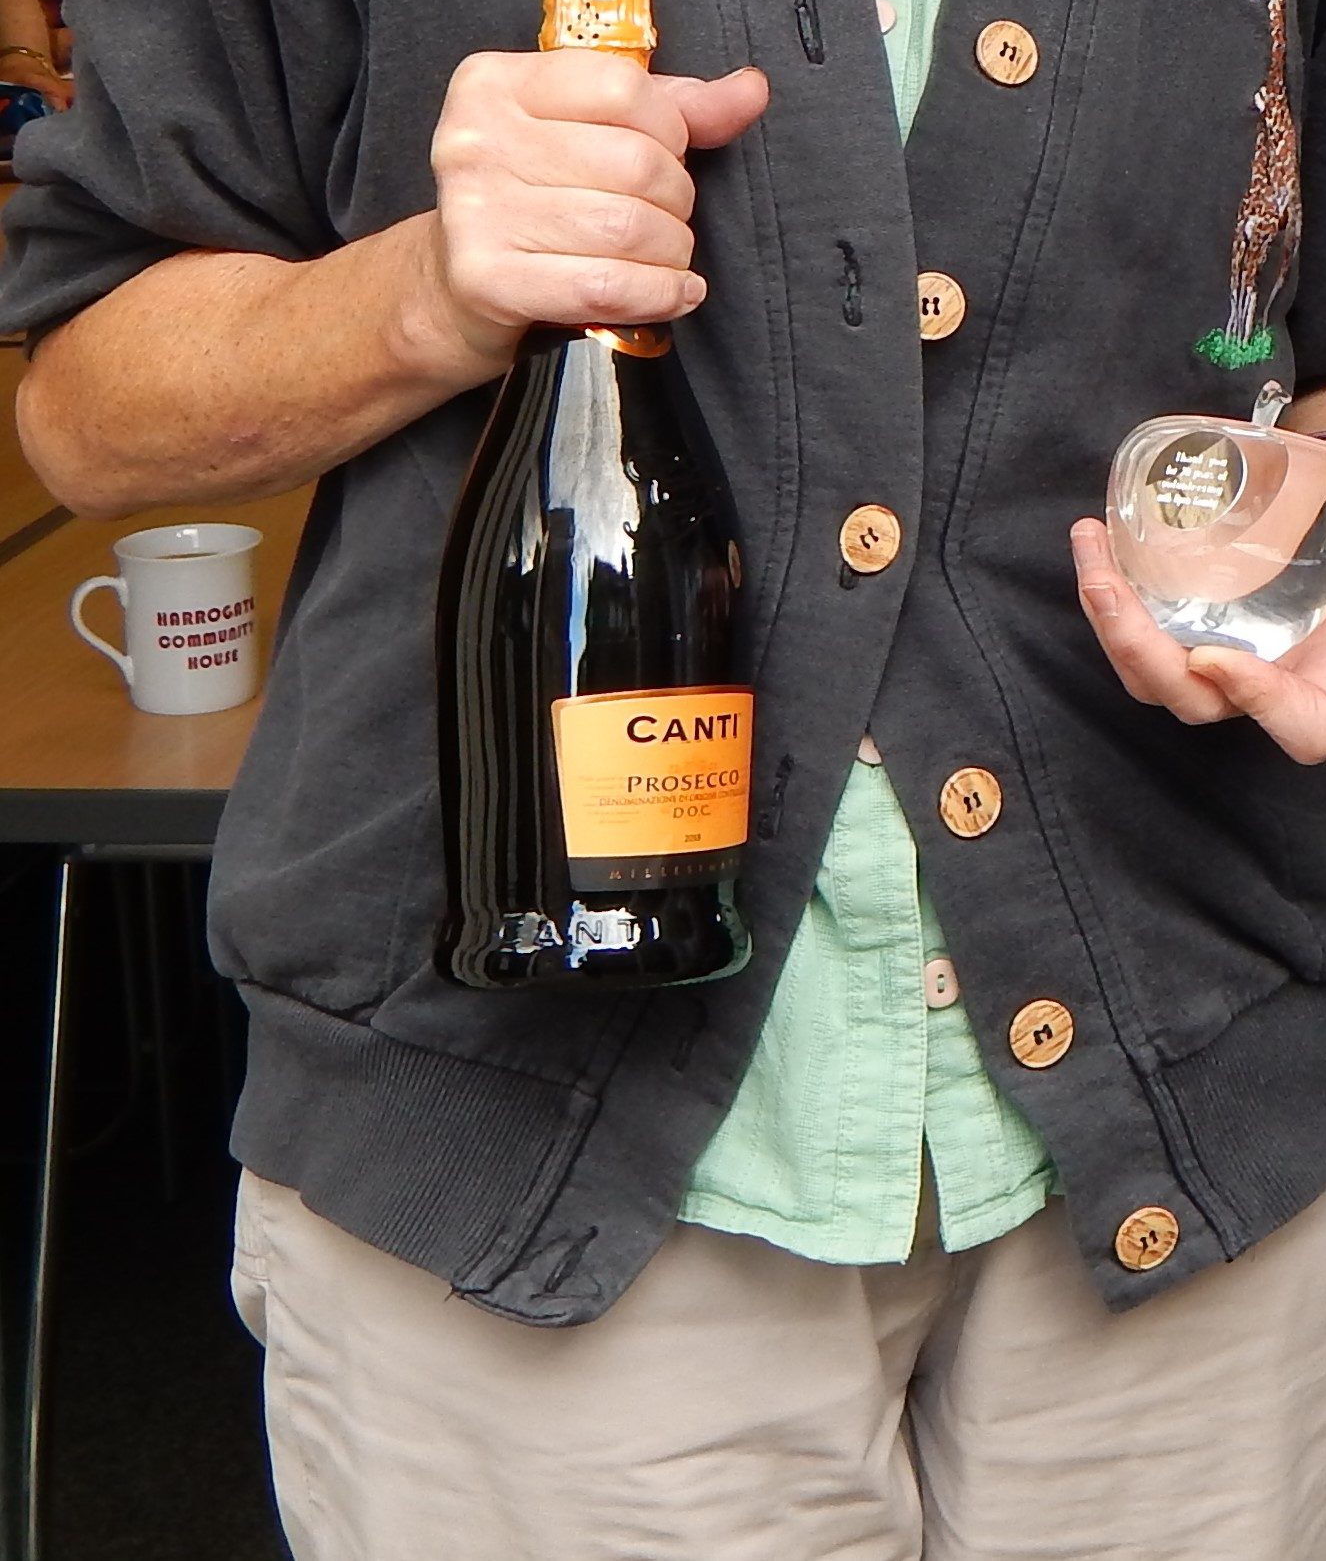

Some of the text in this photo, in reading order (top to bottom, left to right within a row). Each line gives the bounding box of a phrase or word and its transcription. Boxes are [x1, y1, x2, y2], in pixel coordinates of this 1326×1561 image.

[187, 649, 239, 670] HOUSE
[626, 713, 739, 743] CANTI
[627, 769, 740, 793] PROSECCO
